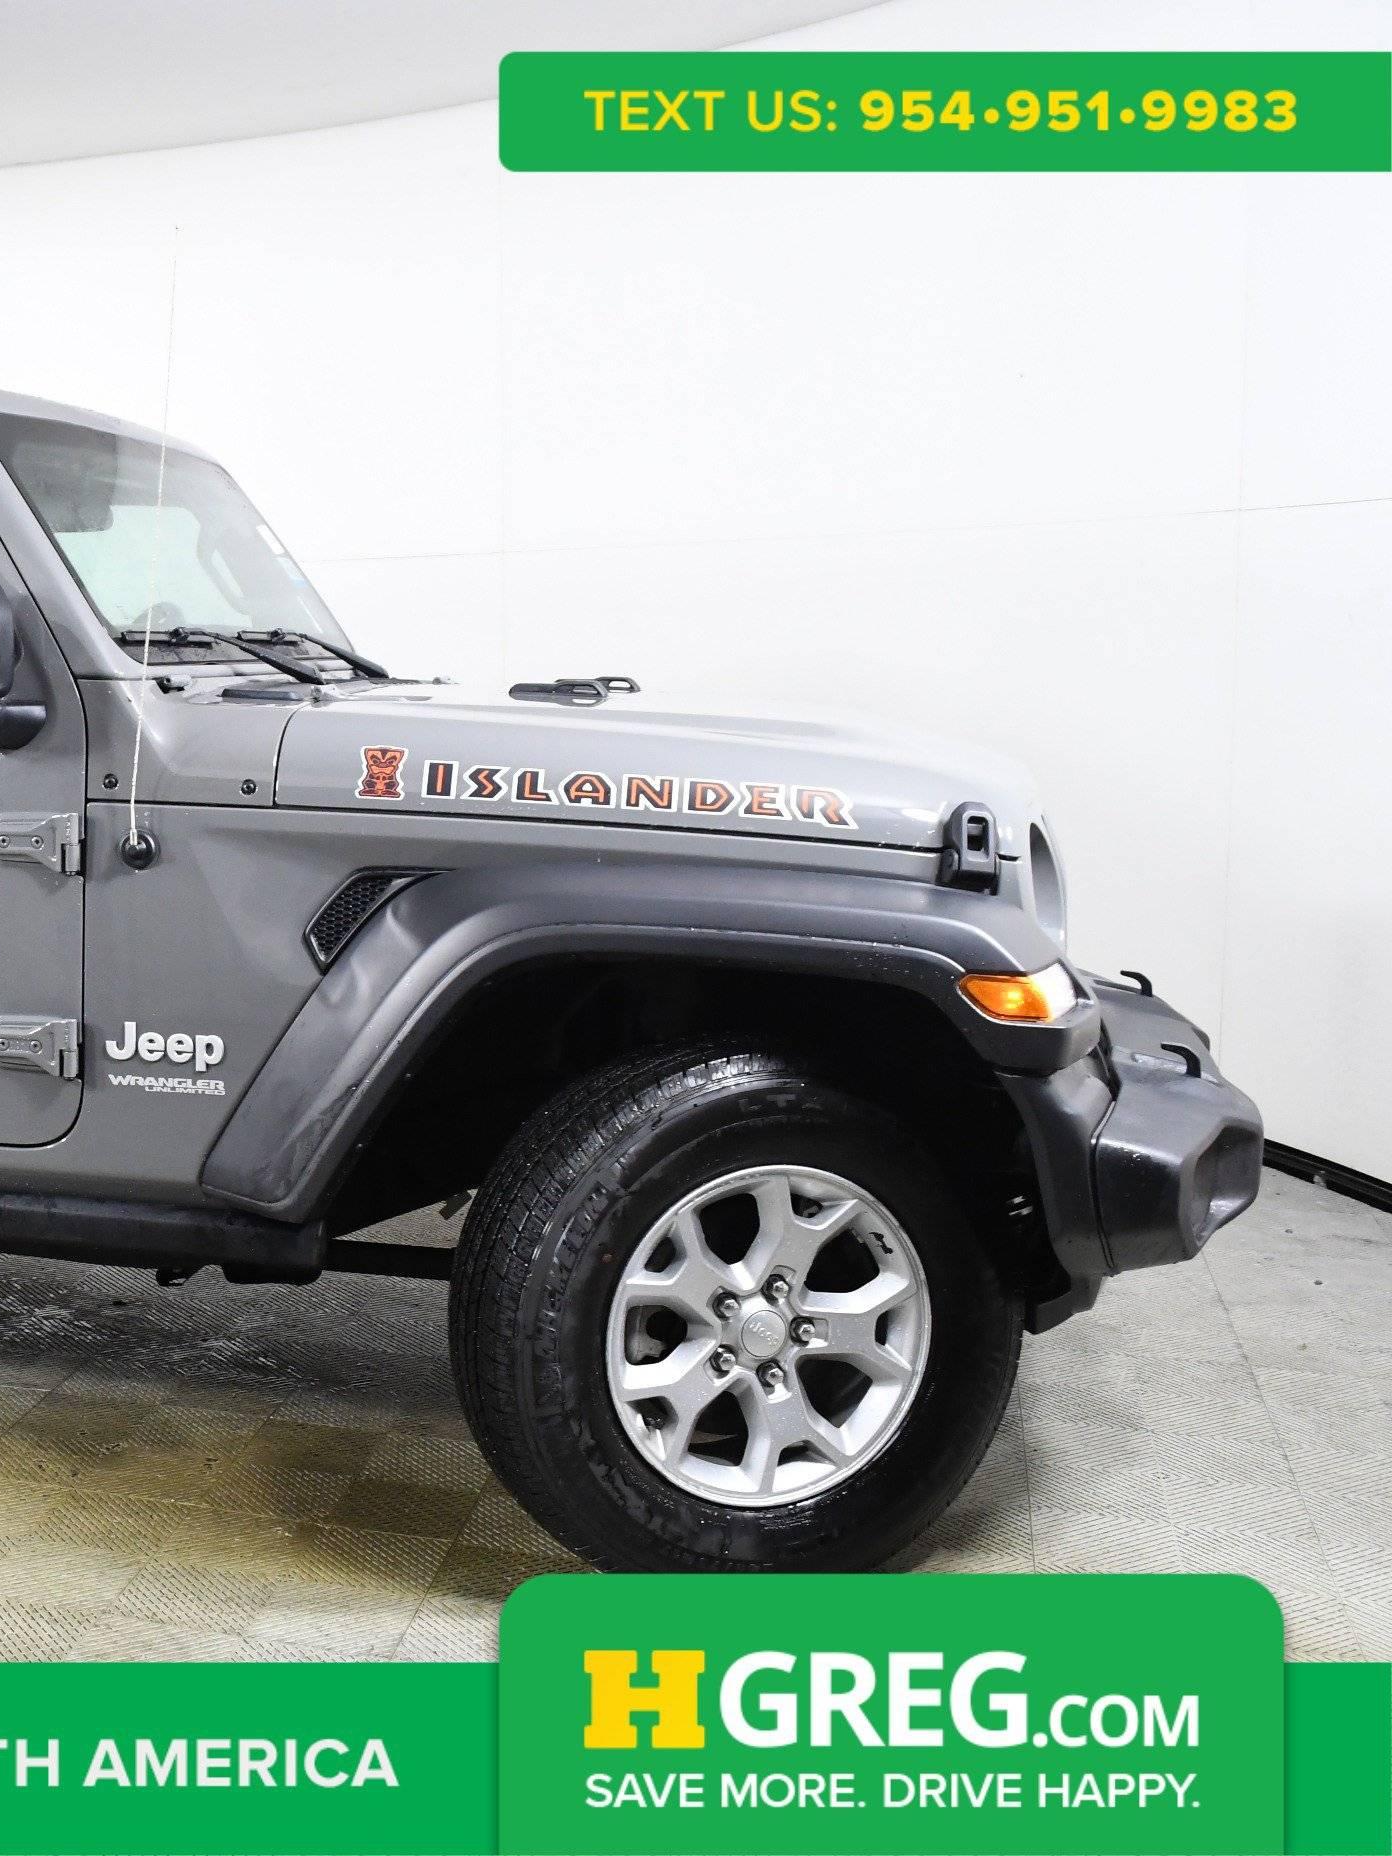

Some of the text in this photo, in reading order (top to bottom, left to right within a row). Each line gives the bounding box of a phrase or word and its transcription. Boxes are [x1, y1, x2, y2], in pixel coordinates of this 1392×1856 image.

[422, 760, 855, 827] ISLANDER
[105, 1021, 225, 1072] Jeep
[108, 1073, 225, 1091] WRANGLER
[145, 1086, 226, 1096] UNLIMITED
